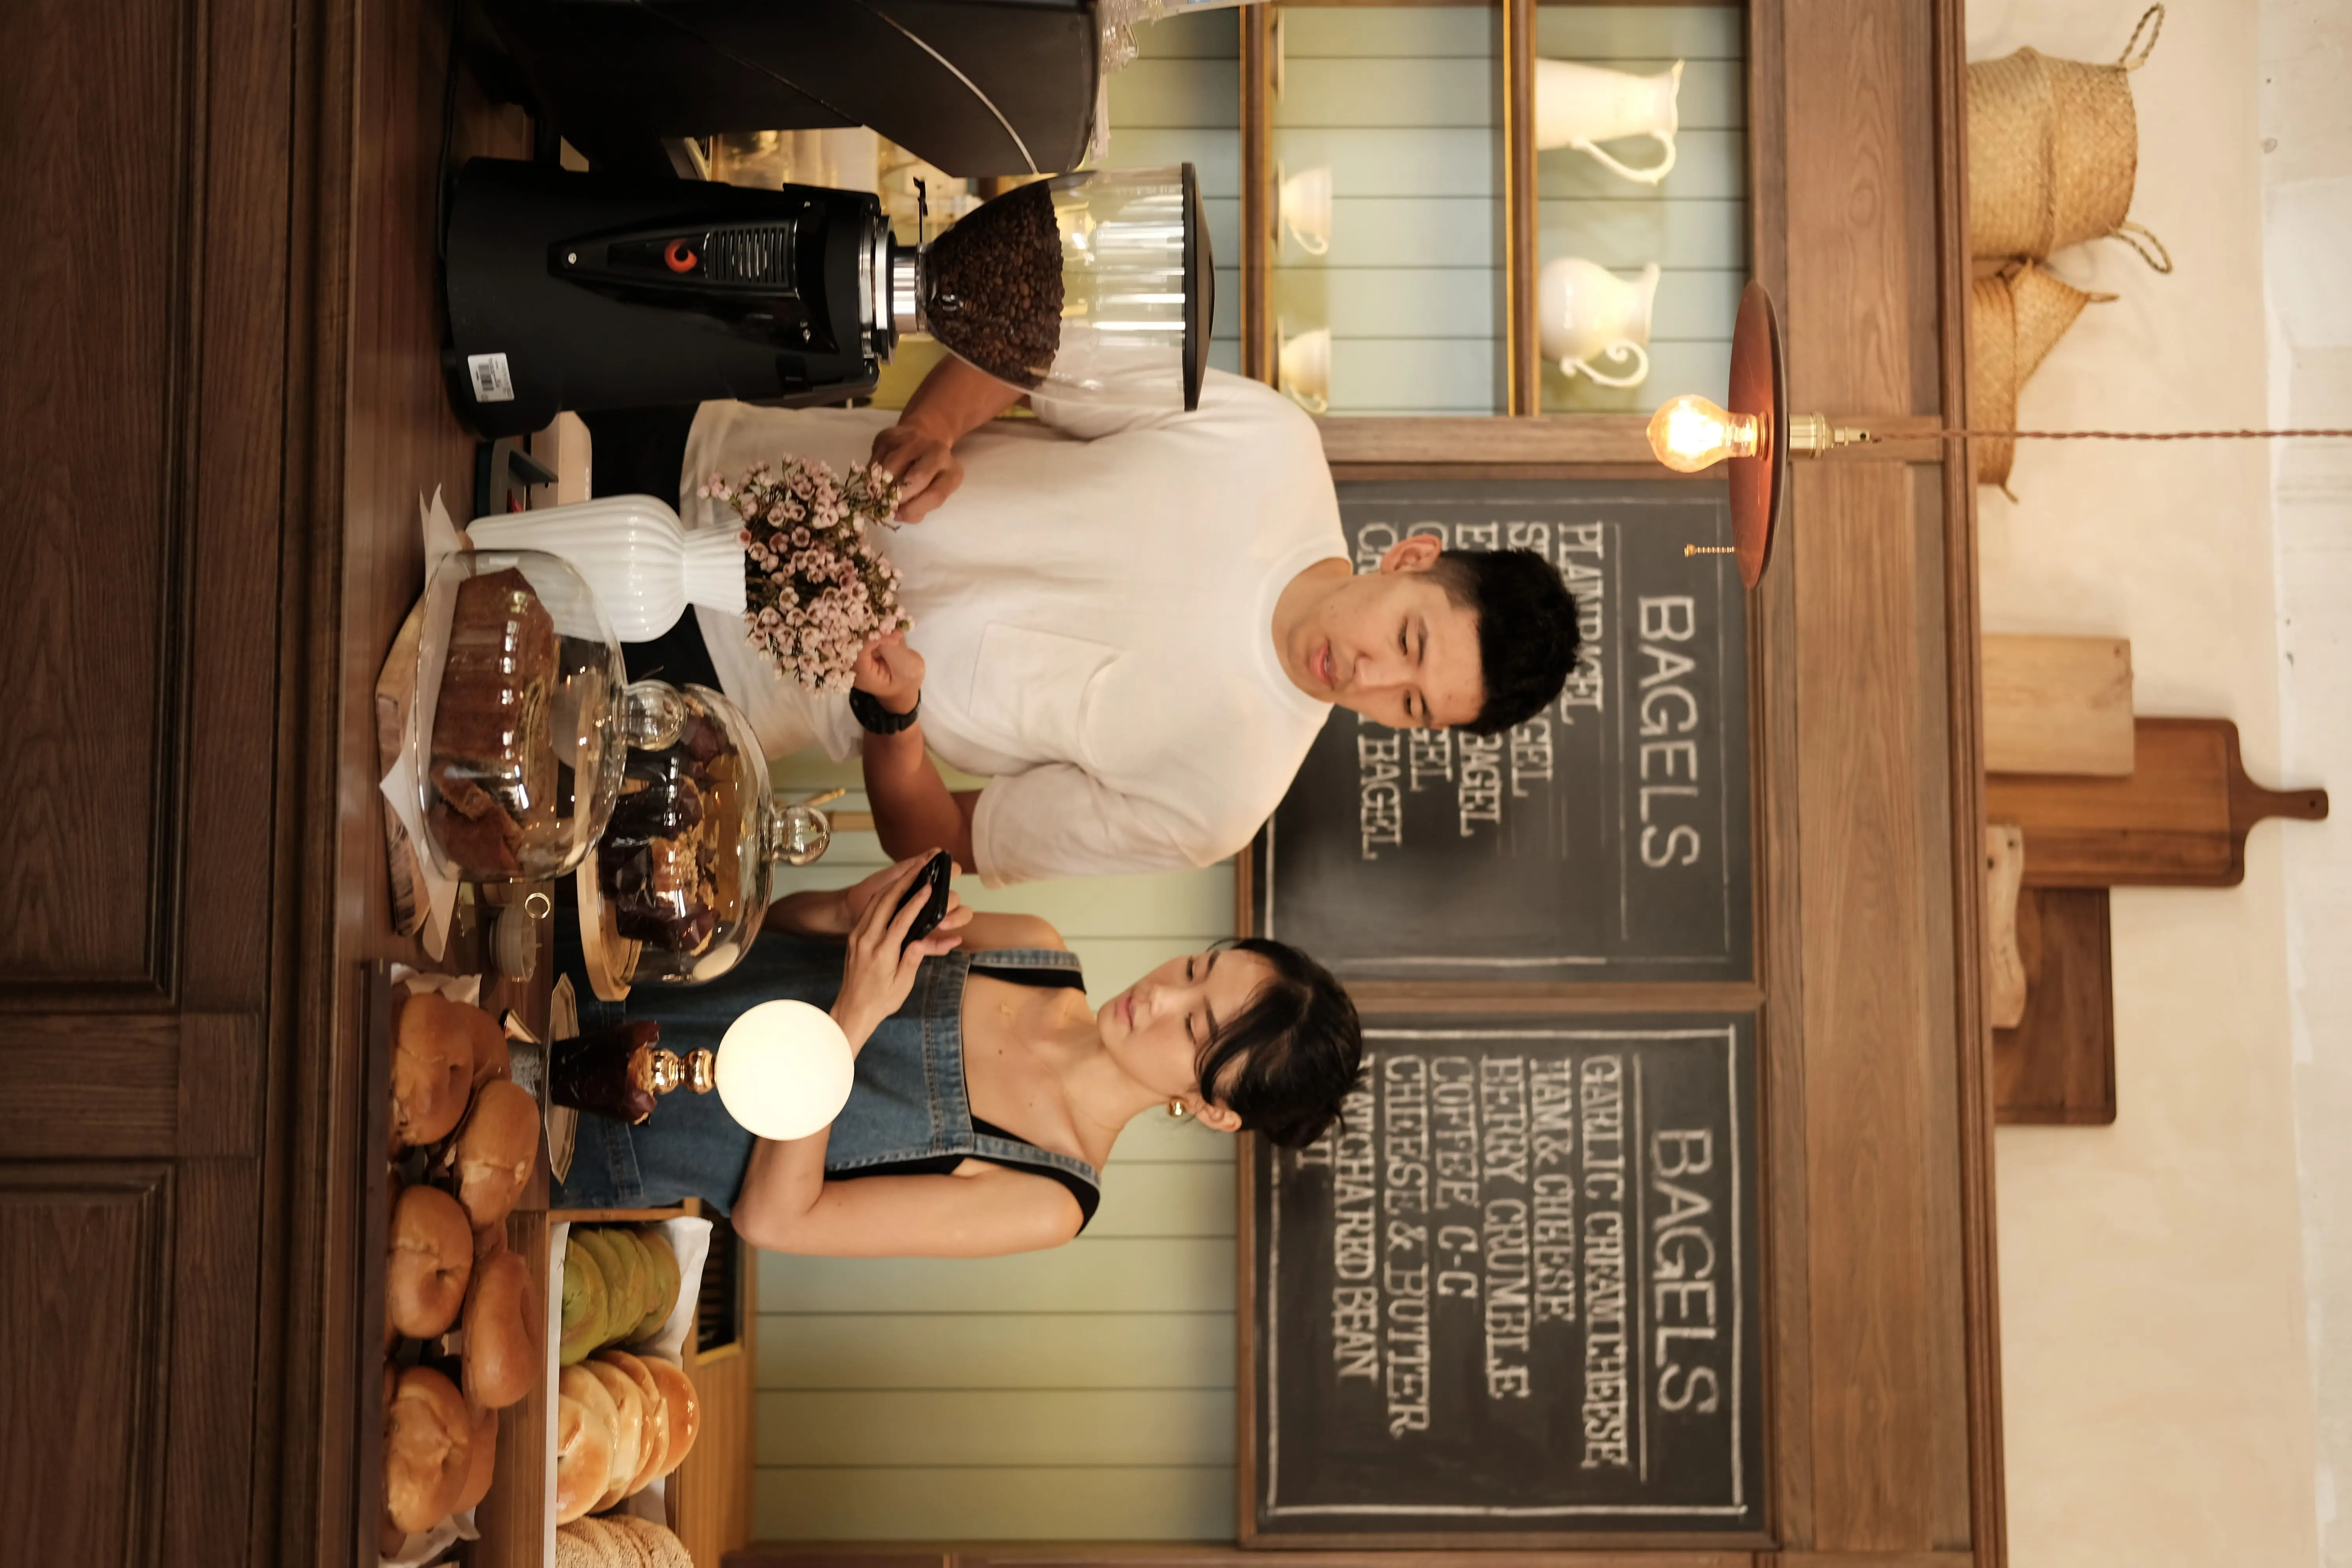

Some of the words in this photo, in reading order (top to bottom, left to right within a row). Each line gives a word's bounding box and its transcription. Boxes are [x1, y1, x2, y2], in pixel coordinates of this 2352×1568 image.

[1357, 733, 1403, 861] BAGEL
[1638, 596, 1700, 868] BAGELS
[1384, 1054, 1430, 1215] CHEESE
[1430, 1056, 1481, 1210] COFFEE
[1480, 1054, 1528, 1185] BERRY
[1530, 1058, 1573, 1133] HAM
[1531, 1135, 1573, 1169] &
[1581, 1055, 1626, 1201] GARLIC
[1333, 1207, 1376, 1280] RED
[1387, 1220, 1428, 1253] &
[1437, 1224, 1479, 1299] C-C
[1484, 1198, 1532, 1401] CRUMBLE
[1532, 1174, 1575, 1325] CHEESE
[1650, 1128, 1719, 1414] BAGELS
[1331, 1286, 1379, 1384] BEAN
[1383, 1260, 1431, 1440] BUTTER
[1580, 1333, 1628, 1469] CHEESE
